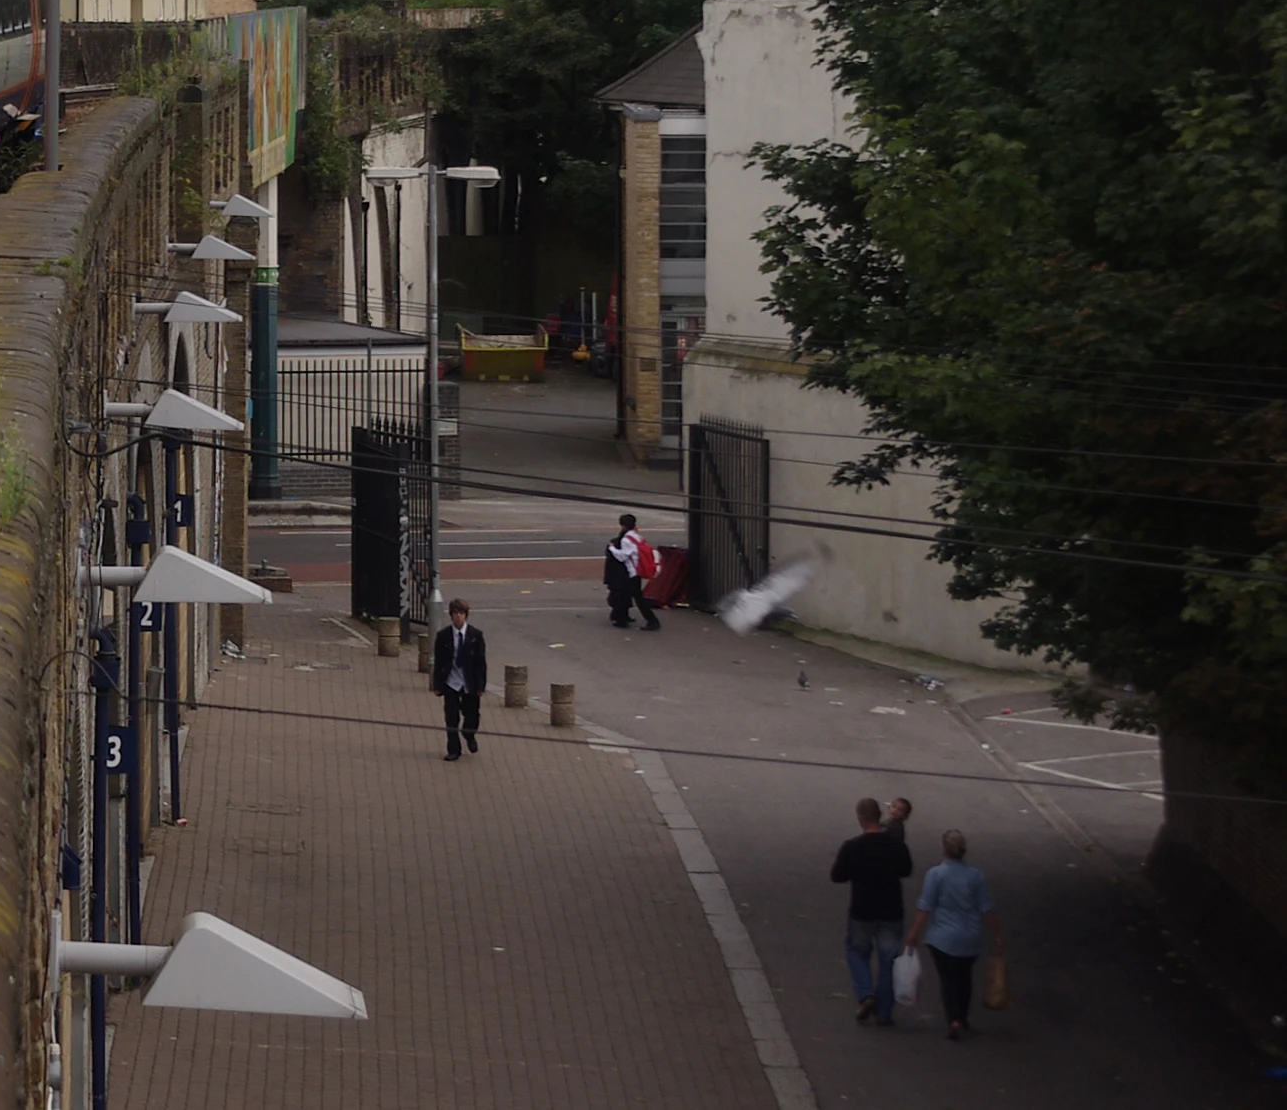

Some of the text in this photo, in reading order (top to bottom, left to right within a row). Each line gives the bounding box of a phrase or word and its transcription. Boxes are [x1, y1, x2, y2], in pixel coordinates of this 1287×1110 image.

[173, 499, 183, 523] 1
[140, 601, 153, 627] 2
[106, 735, 122, 768] 3
